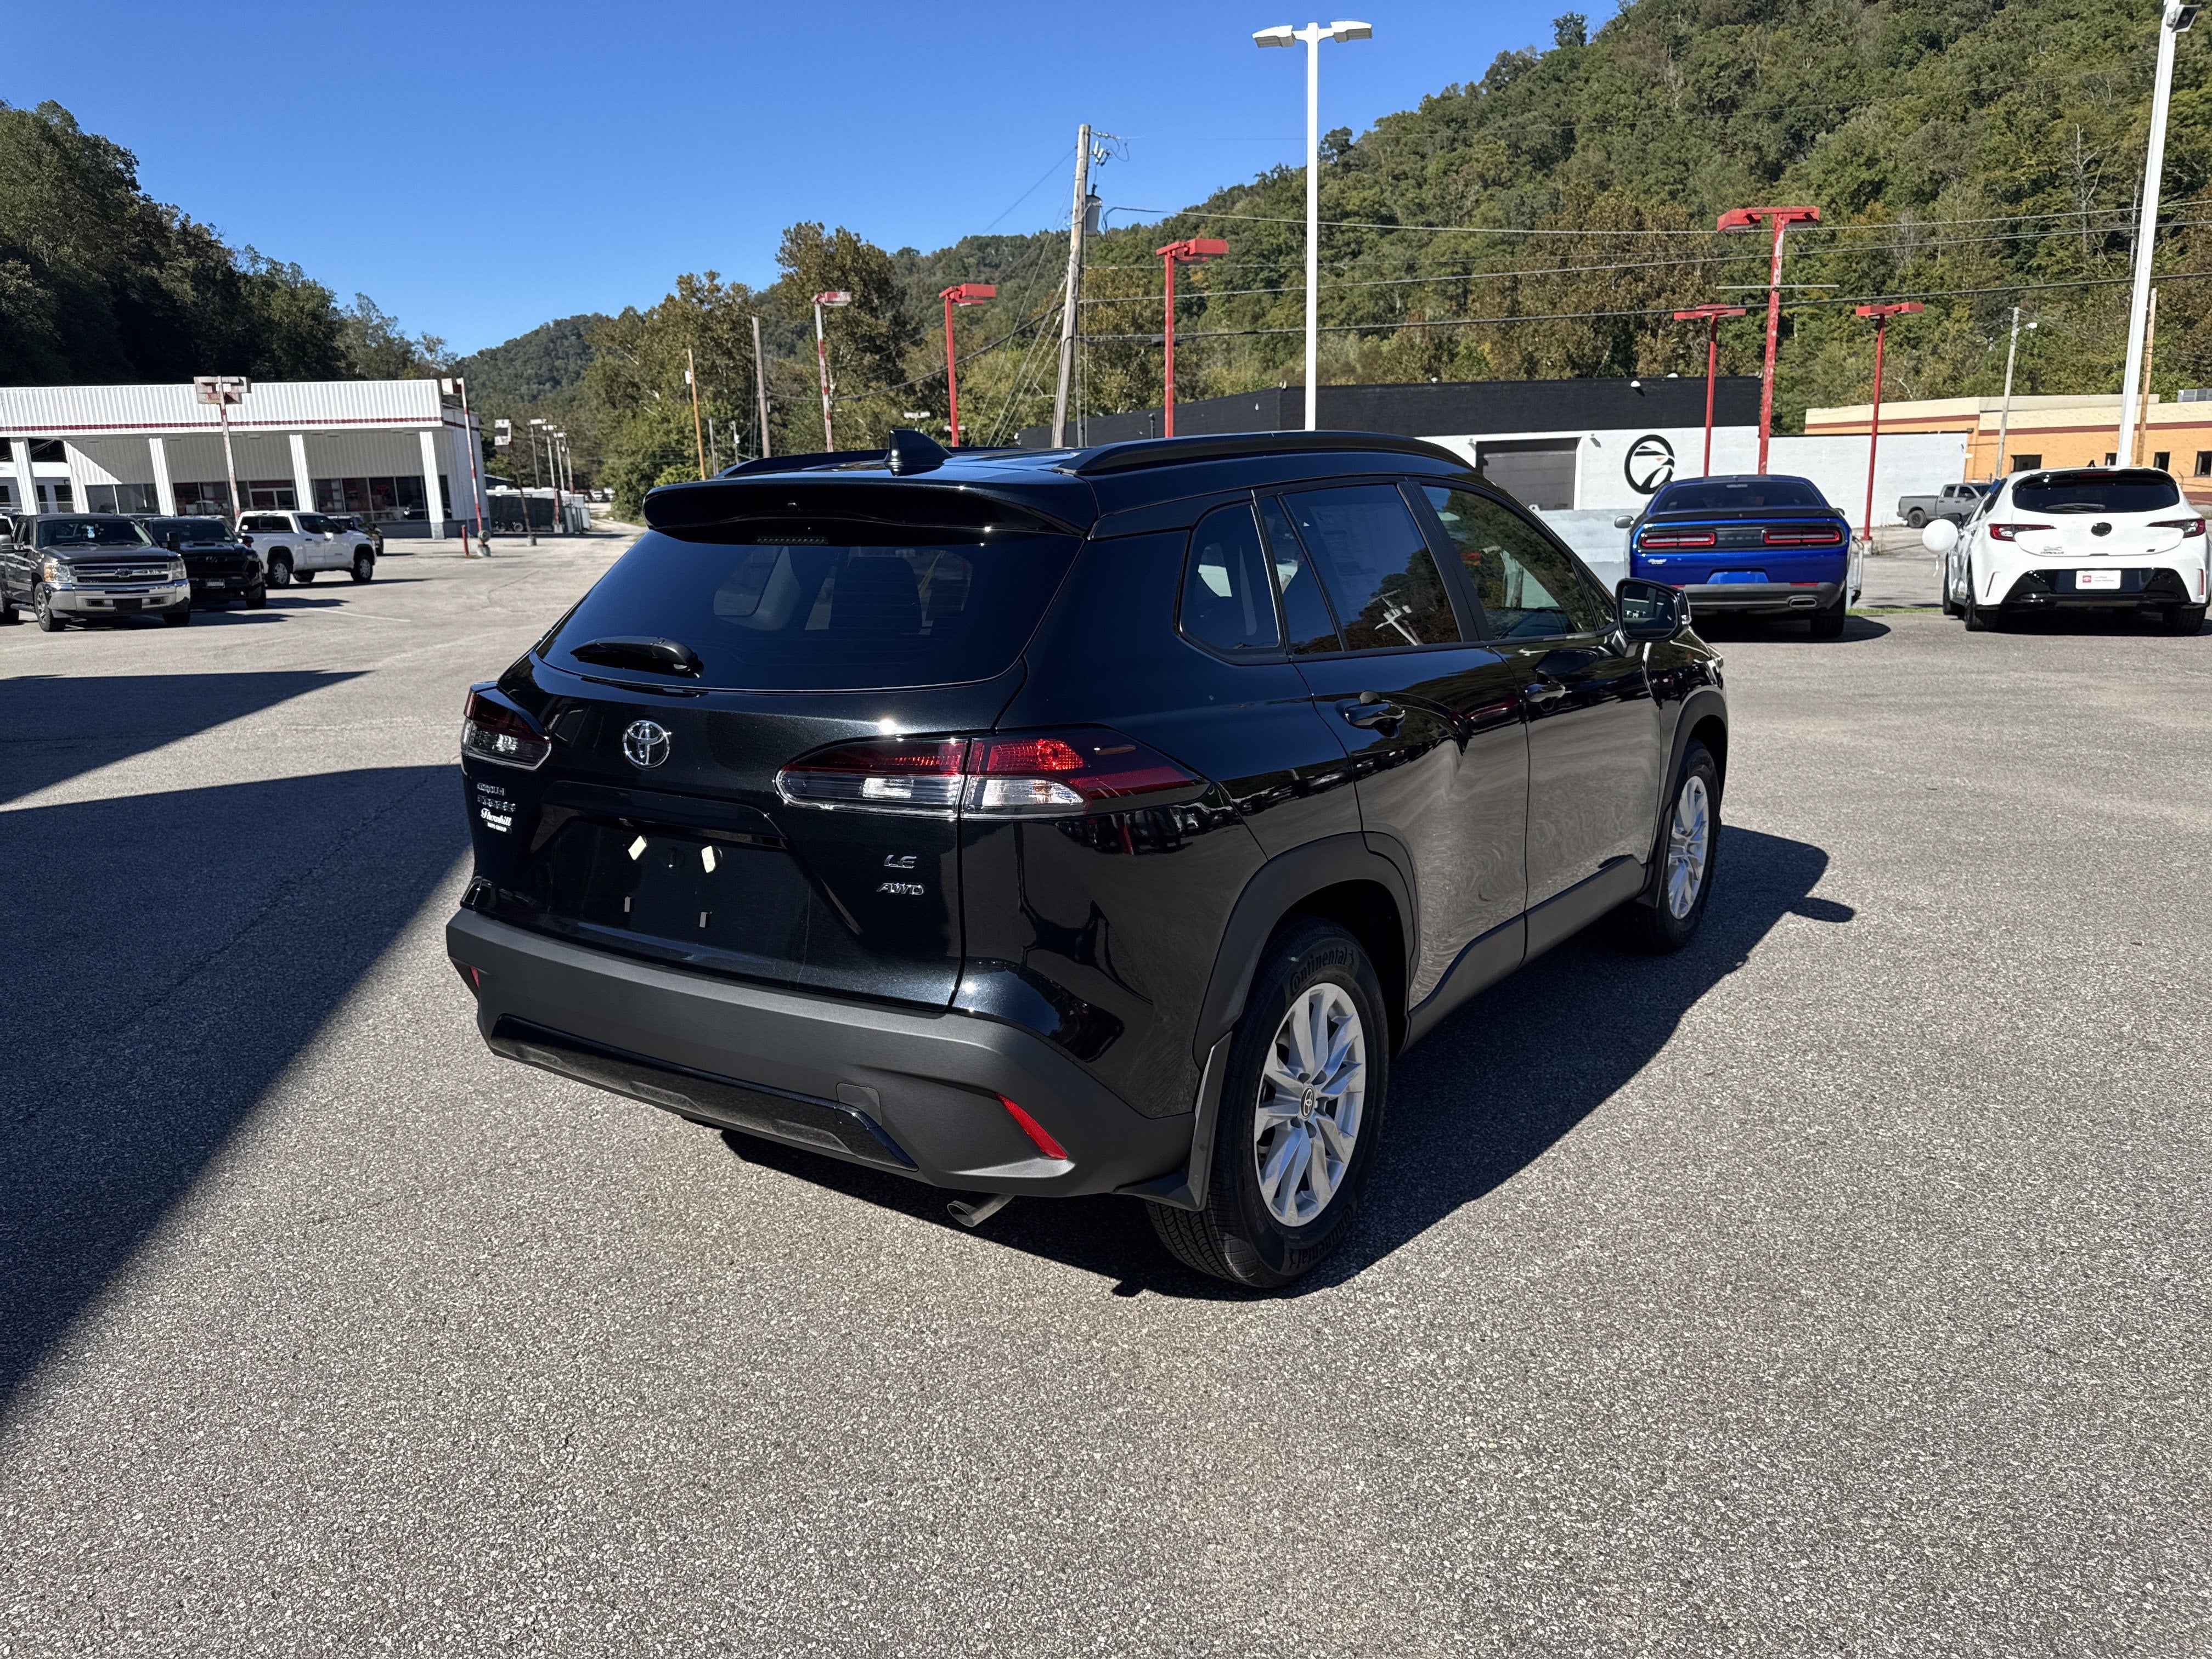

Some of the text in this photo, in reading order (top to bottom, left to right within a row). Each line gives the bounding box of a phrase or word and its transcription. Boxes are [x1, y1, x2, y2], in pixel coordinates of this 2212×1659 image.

[884, 854, 917, 869] LE
[876, 883, 924, 895] AWD
[1290, 946, 1347, 996] Continental
